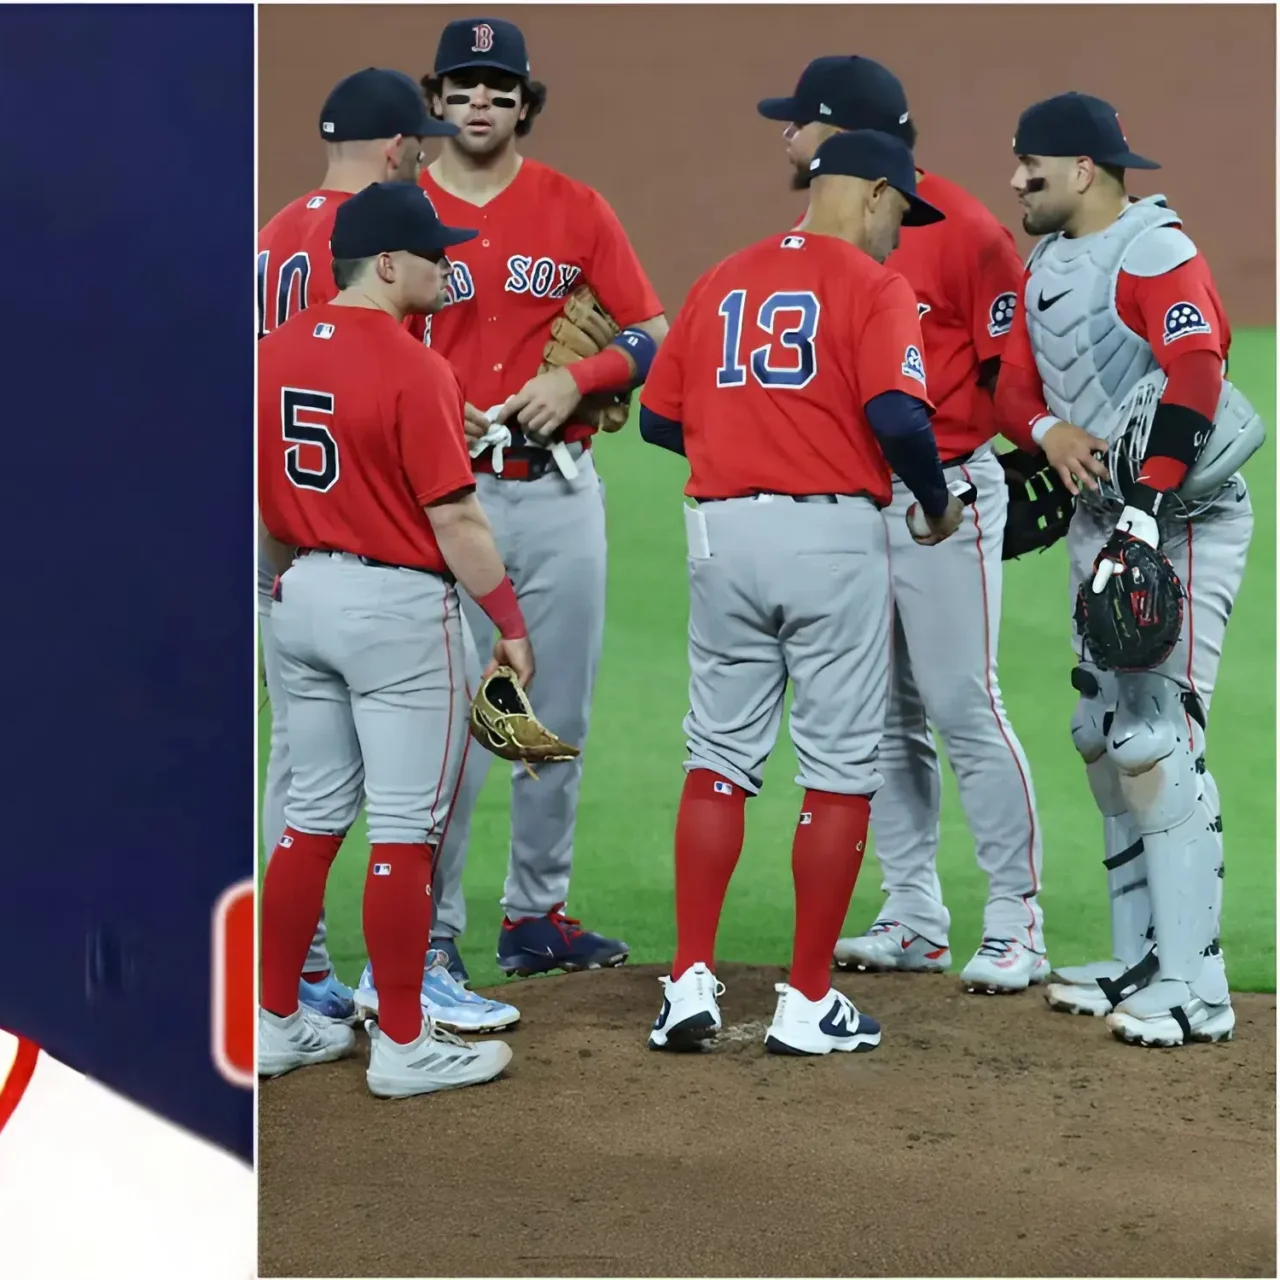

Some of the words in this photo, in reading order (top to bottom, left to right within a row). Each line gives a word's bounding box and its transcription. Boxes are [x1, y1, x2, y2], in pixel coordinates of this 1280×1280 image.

[505, 254, 581, 299] SOX
[717, 289, 820, 390] 13
[281, 386, 340, 493] 5
